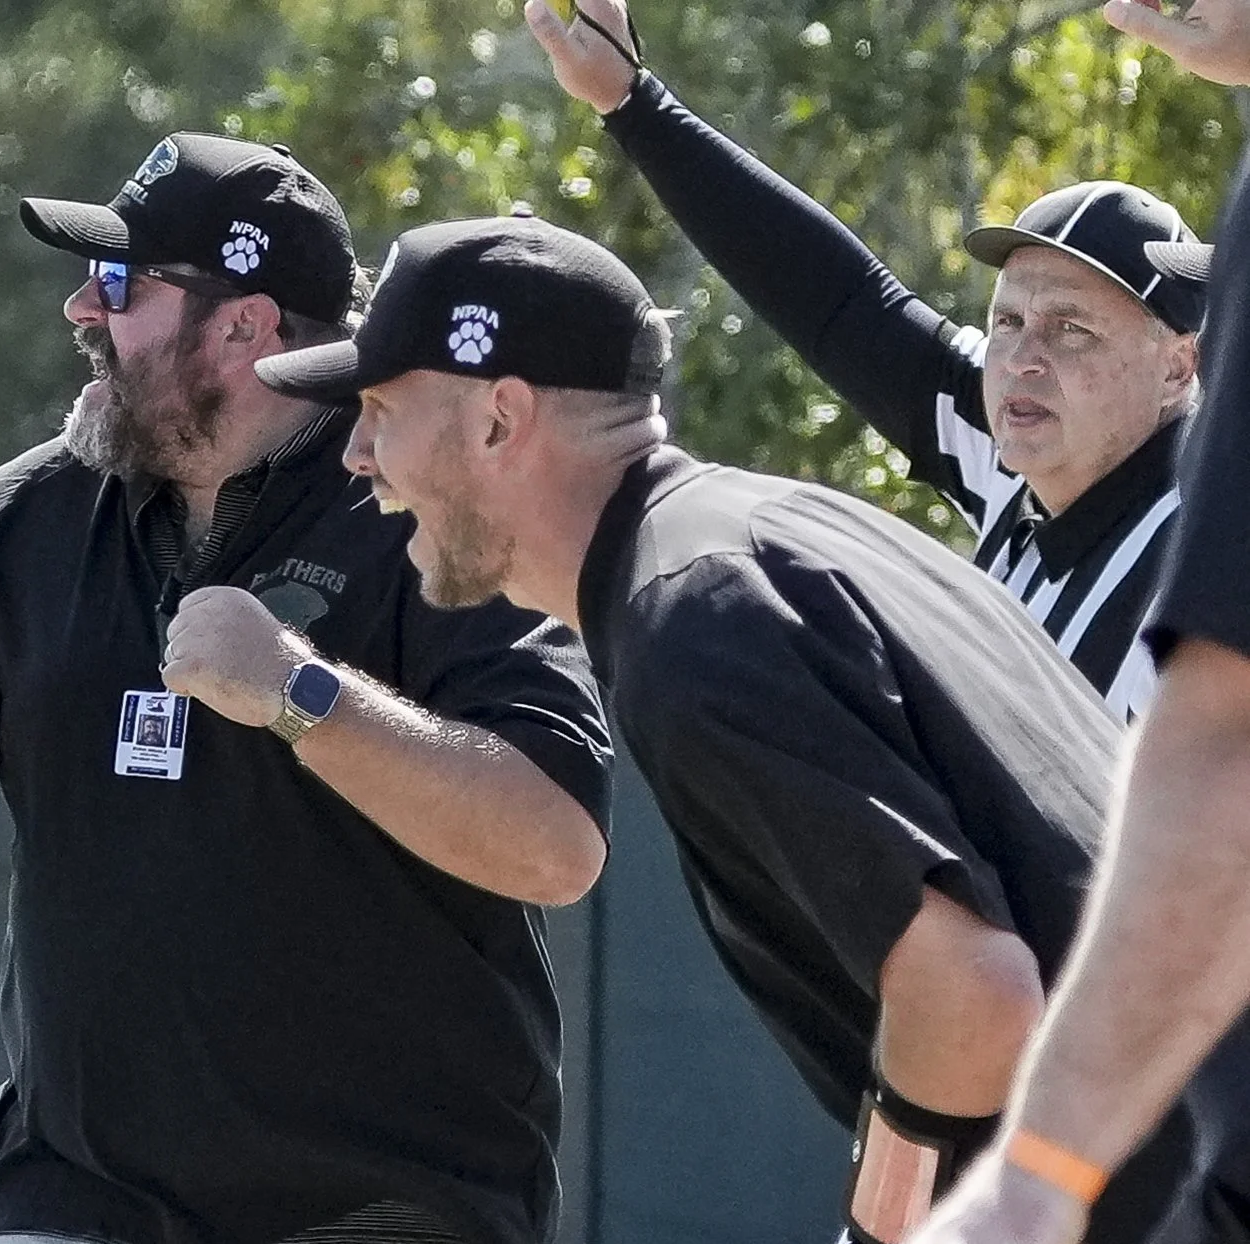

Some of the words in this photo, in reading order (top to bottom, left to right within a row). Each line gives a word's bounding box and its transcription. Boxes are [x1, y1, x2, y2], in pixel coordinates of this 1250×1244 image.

[229, 220, 270, 251] NPAA
[452, 304, 499, 329] NPAA
[249, 557, 347, 594] PTHERS
